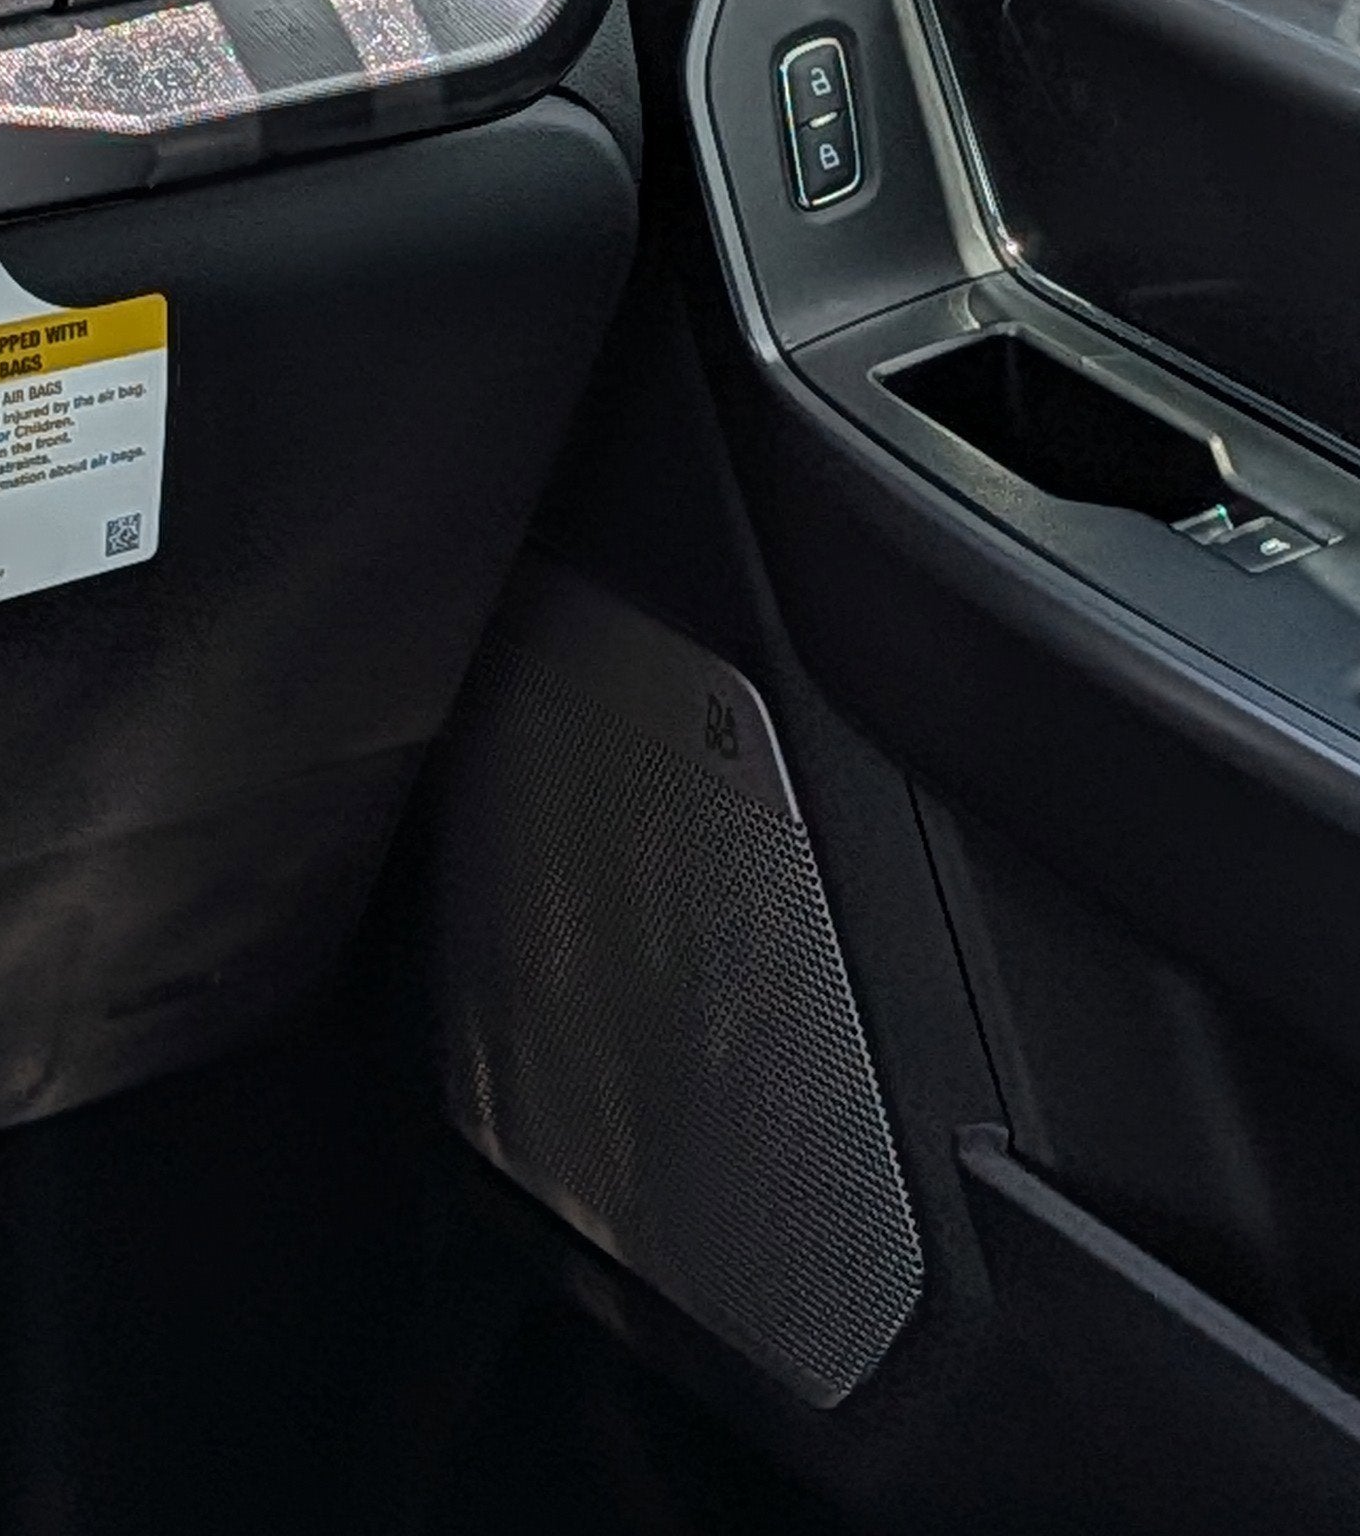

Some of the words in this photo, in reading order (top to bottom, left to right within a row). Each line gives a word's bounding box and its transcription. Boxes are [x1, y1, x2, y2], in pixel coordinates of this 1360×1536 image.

[44, 320, 88, 344] WITH
[0, 354, 43, 379] BAGS
[2, 388, 24, 406] AIR
[28, 380, 63, 400] BAGS
[2, 404, 49, 425] injured
[52, 400, 70, 416] by
[74, 394, 94, 409] the
[97, 387, 115, 403] air
[118, 383, 147, 401] bag.
[14, 415, 75, 438] Children.
[11, 438, 32, 454] the
[48, 458, 87, 479] about
[91, 452, 108, 469] air
